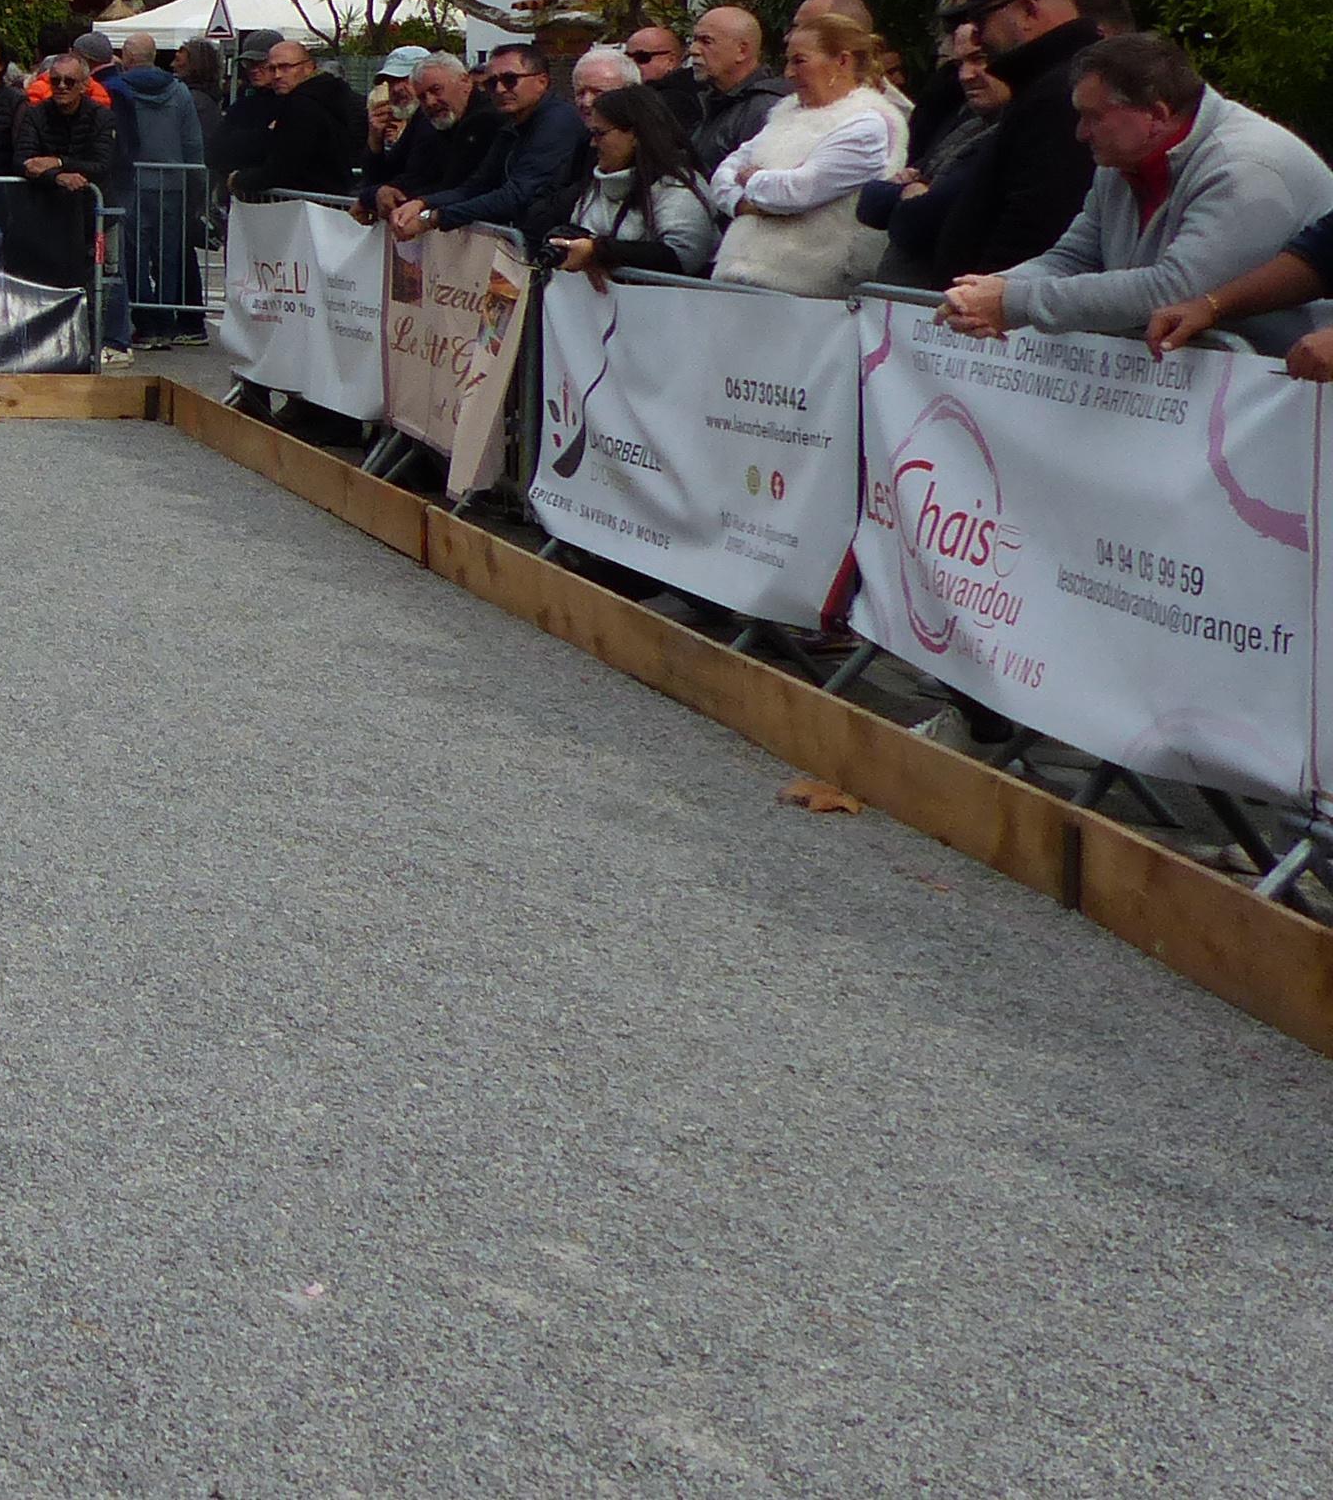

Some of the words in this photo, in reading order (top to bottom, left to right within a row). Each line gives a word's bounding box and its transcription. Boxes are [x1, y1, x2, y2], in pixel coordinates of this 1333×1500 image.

[390, 316, 419, 357] Le
[1015, 336, 1095, 376] CHAMPAGNE
[1100, 351, 1110, 378] &
[1114, 353, 1195, 391] SPIRITUEUX
[725, 376, 807, 412] 0637305442
[944, 357, 967, 381] AUX
[968, 361, 1078, 406] PROFESSIONNELS
[1080, 383, 1091, 407] &
[1093, 386, 1189, 426] PARTICULIERS
[579, 503, 618, 530] SAVEURS
[619, 518, 634, 534] DU
[637, 524, 671, 550] MONDE
[893, 459, 997, 567] Chais
[933, 559, 1023, 627] lavandou
[1096, 537, 1113, 568] 04
[1118, 543, 1132, 574] 94
[1158, 556, 1175, 589] 99
[1180, 563, 1204, 597] 59
[1002, 651, 1045, 689] VINS
